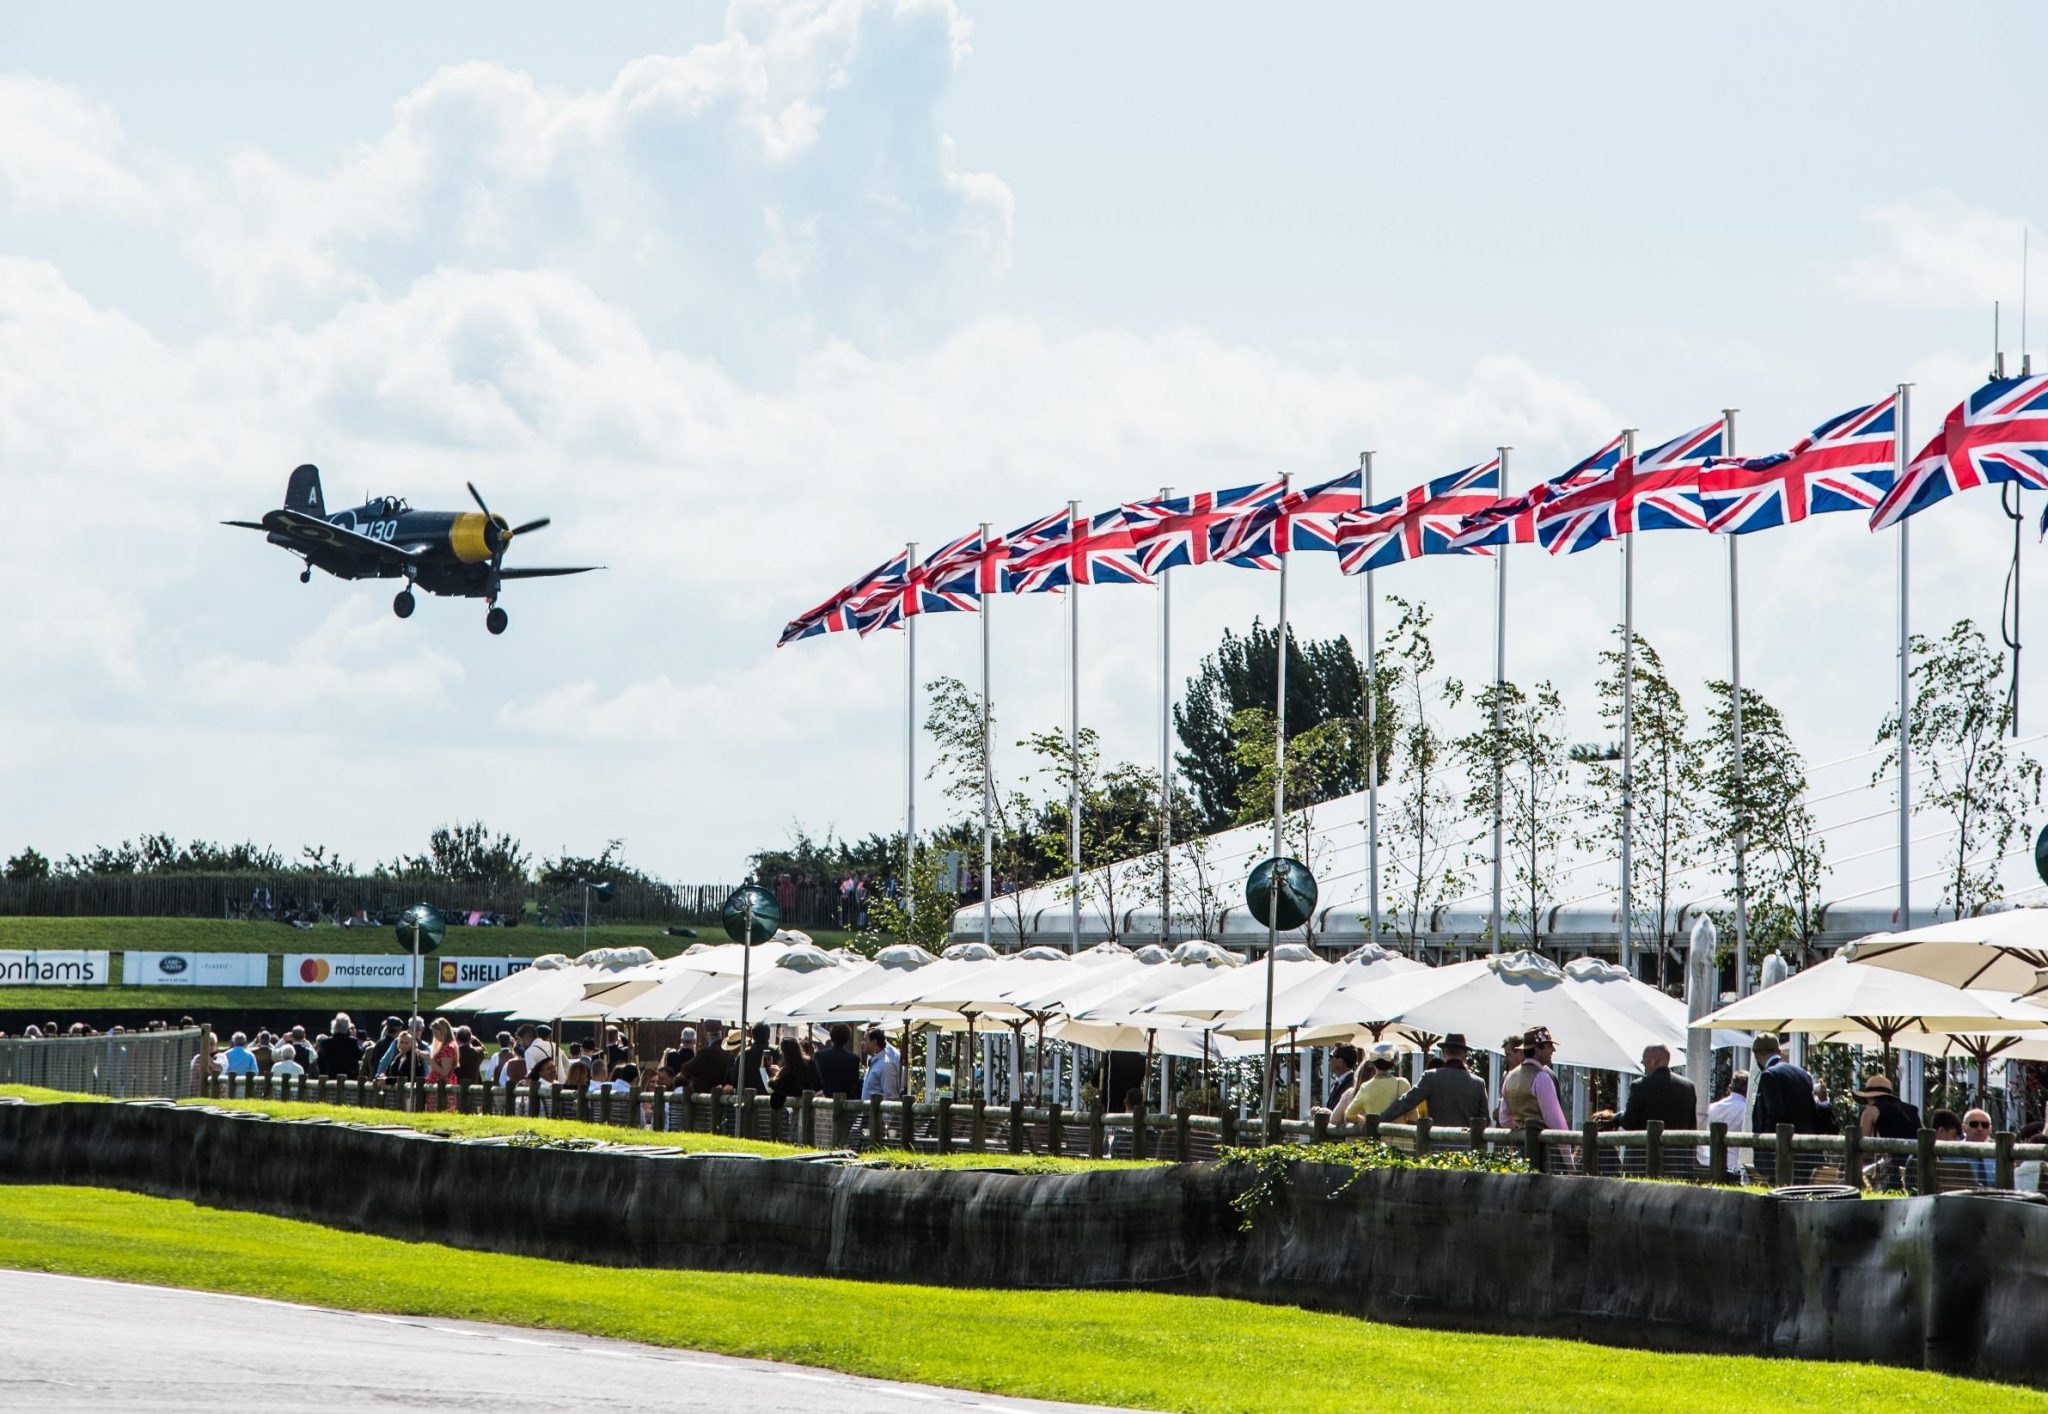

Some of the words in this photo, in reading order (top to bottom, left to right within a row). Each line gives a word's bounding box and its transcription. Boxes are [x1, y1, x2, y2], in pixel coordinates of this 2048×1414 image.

[308, 486, 317, 504] A
[368, 520, 398, 541] 130
[335, 963, 405, 976] mastercard
[461, 964, 502, 981] SHELL
